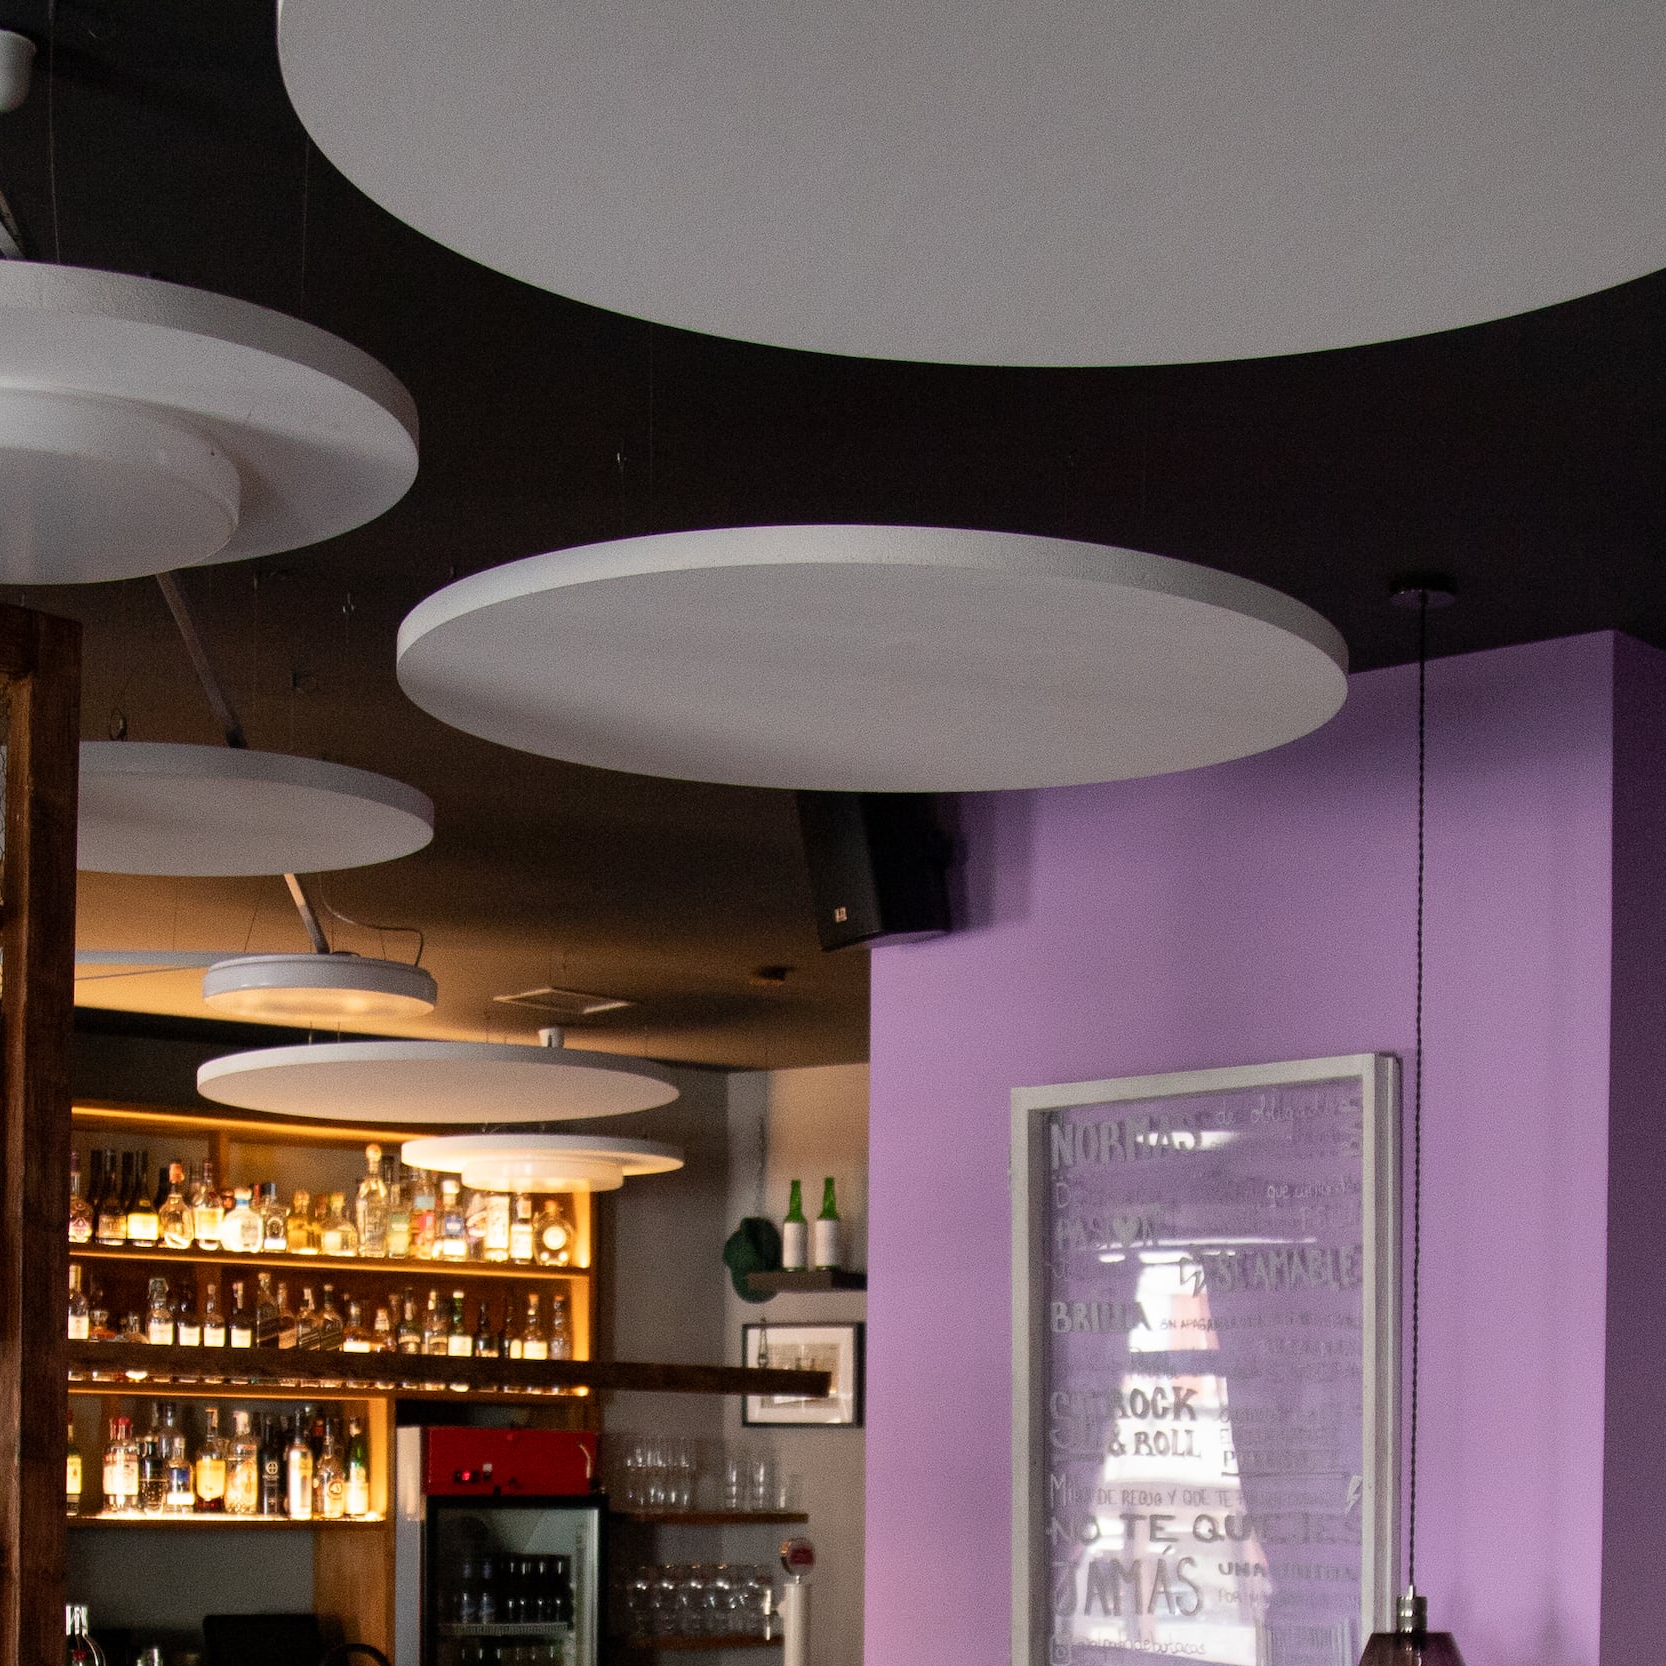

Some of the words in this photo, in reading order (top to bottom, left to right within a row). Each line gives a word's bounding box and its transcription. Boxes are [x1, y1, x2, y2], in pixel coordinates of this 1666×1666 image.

[1108, 1386, 1199, 1421] ROCK
[1134, 1429, 1201, 1458] ROLL
[1120, 1512, 1179, 1543] TE
[1051, 1546, 1204, 1617] JAMÁS
